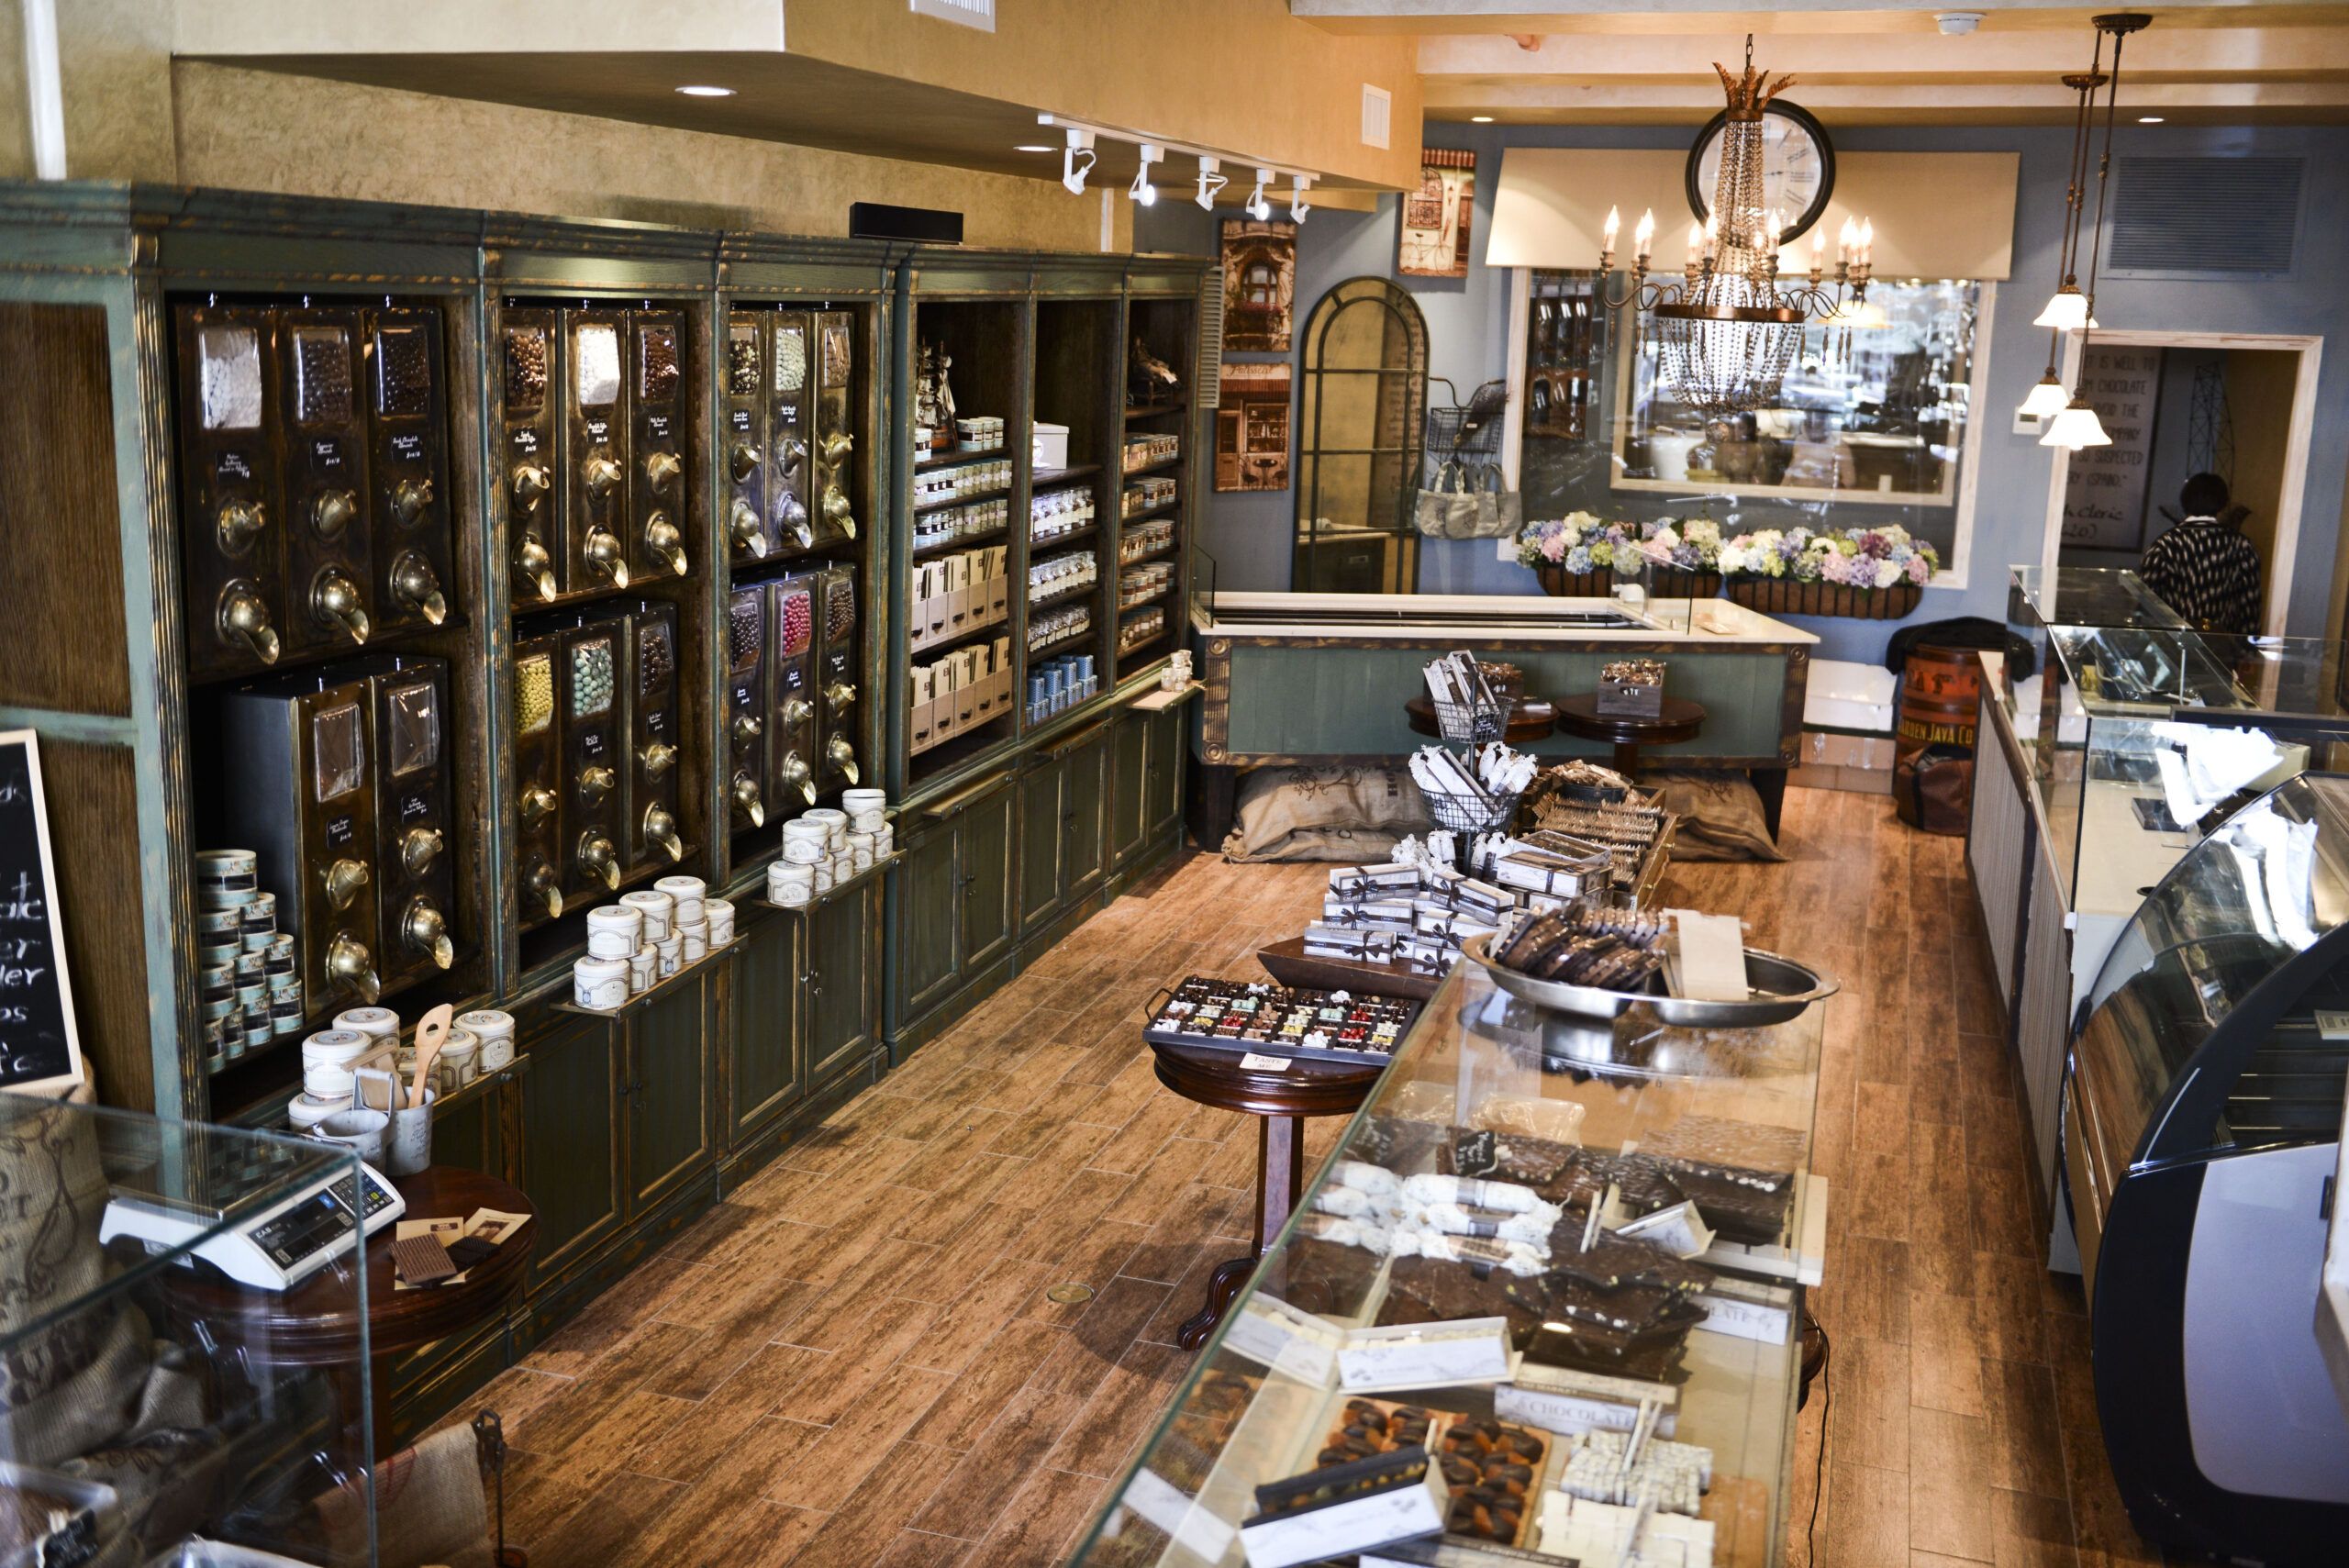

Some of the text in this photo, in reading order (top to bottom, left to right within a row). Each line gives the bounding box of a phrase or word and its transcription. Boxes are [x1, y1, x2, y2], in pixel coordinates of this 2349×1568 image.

[2099, 378, 2148, 395] CHOCOLATE
[2122, 403, 2141, 419] THE
[2095, 450, 2144, 466] SUSPECTED
[1253, 1056, 1282, 1065] TASTE
